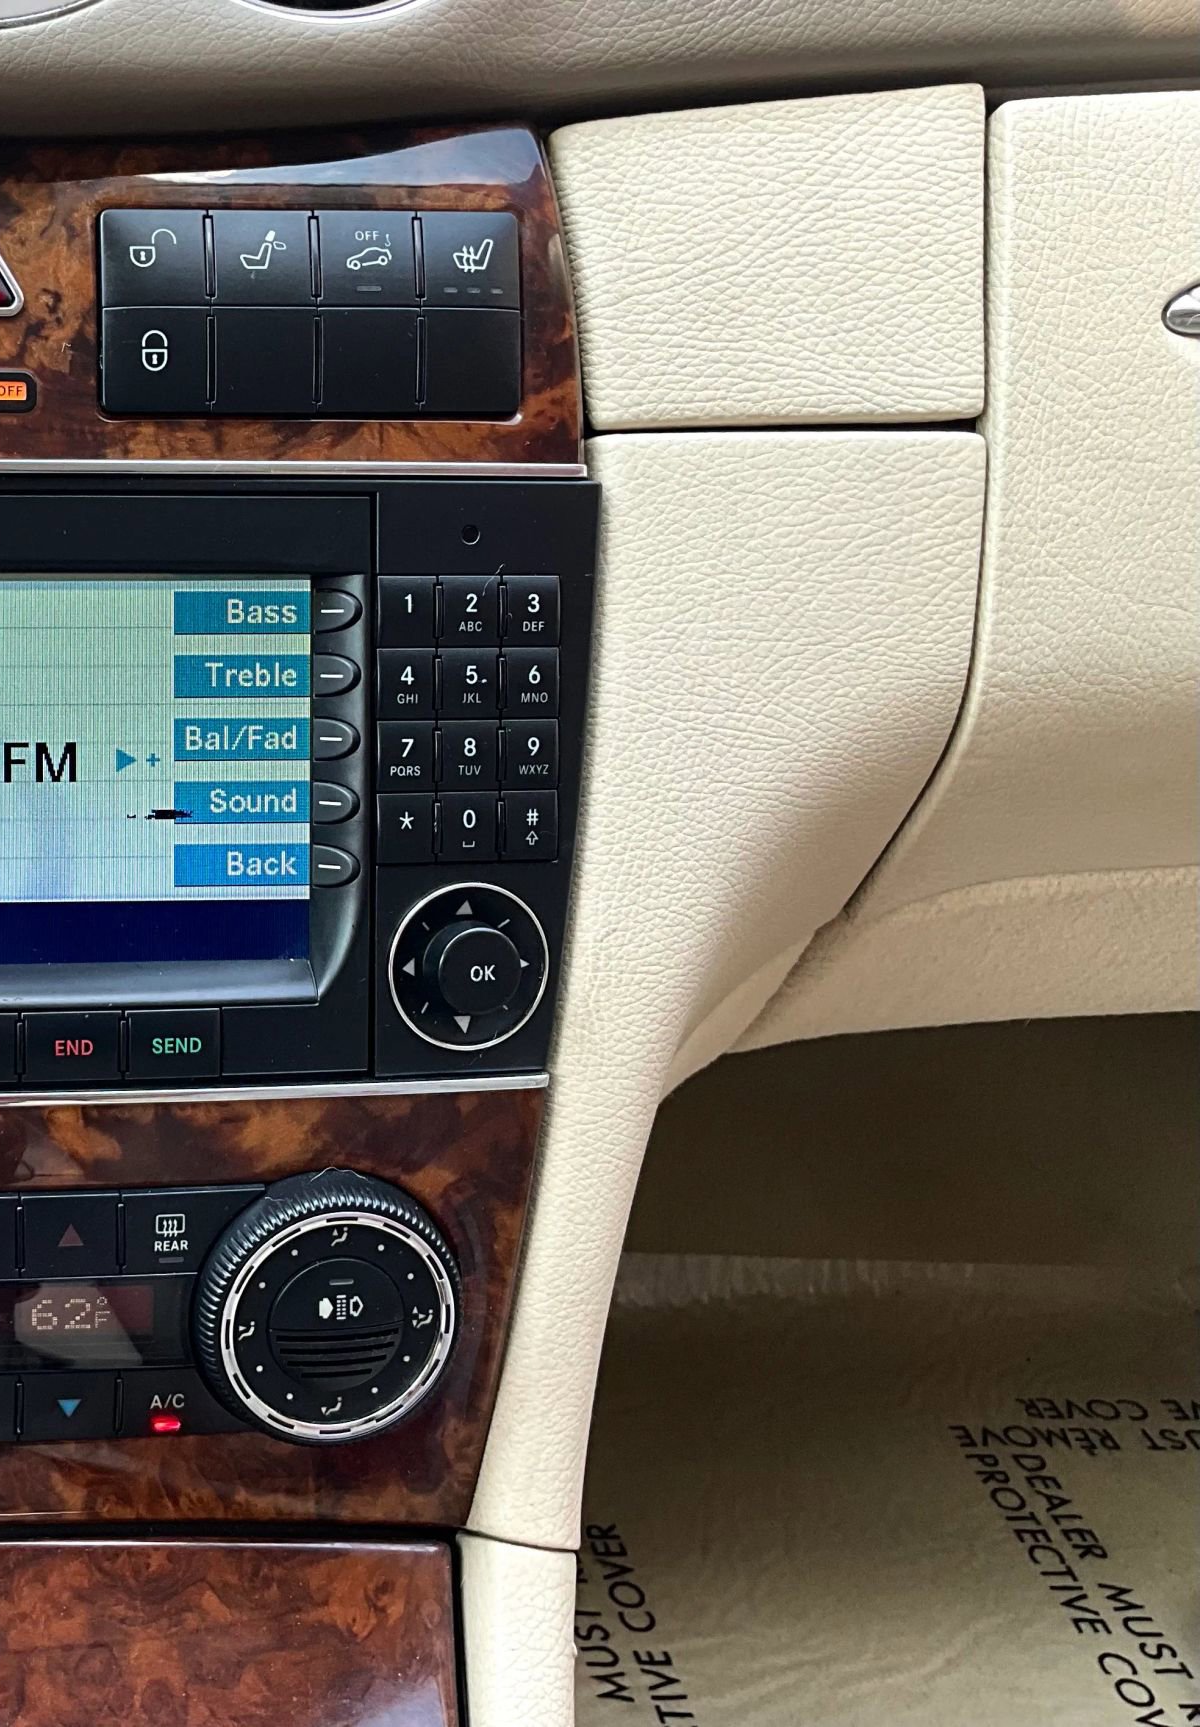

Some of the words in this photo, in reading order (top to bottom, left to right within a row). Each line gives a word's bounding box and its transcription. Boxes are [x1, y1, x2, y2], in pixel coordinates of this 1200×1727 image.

[354, 230, 380, 241] OFF
[227, 598, 298, 624] Bass
[404, 593, 413, 614] 1
[465, 593, 478, 613] 2
[527, 593, 540, 613] 3
[458, 620, 483, 632] ABC
[522, 620, 545, 632] DEF
[204, 661, 297, 688] Treble
[400, 665, 415, 686] 4
[528, 664, 541, 685] 6
[396, 693, 419, 705] GHI
[462, 692, 482, 704] JKL
[520, 691, 549, 703] MNO
[185, 724, 297, 751] Bal/Fad
[463, 737, 477, 757] 8
[527, 736, 540, 756] 9
[401, 738, 414, 758] 7
[3, 741, 77, 784] FM
[389, 765, 421, 777] PQRS
[457, 764, 482, 776] TUV
[518, 763, 549, 775] WXYZ
[207, 787, 297, 817] Sound
[462, 809, 476, 829] 0
[223, 849, 301, 881] Back
[470, 964, 496, 982] OK
[55, 1039, 94, 1057] END
[151, 1037, 202, 1055] SEND
[154, 1239, 189, 1252] REAR
[150, 1393, 185, 1409] A/C
[965, 1453, 1112, 1634] PROTECTIVE
[1012, 1453, 1108, 1560] DEALER
[1097, 1583, 1195, 1680] MUST
[586, 1523, 657, 1633] COVER
